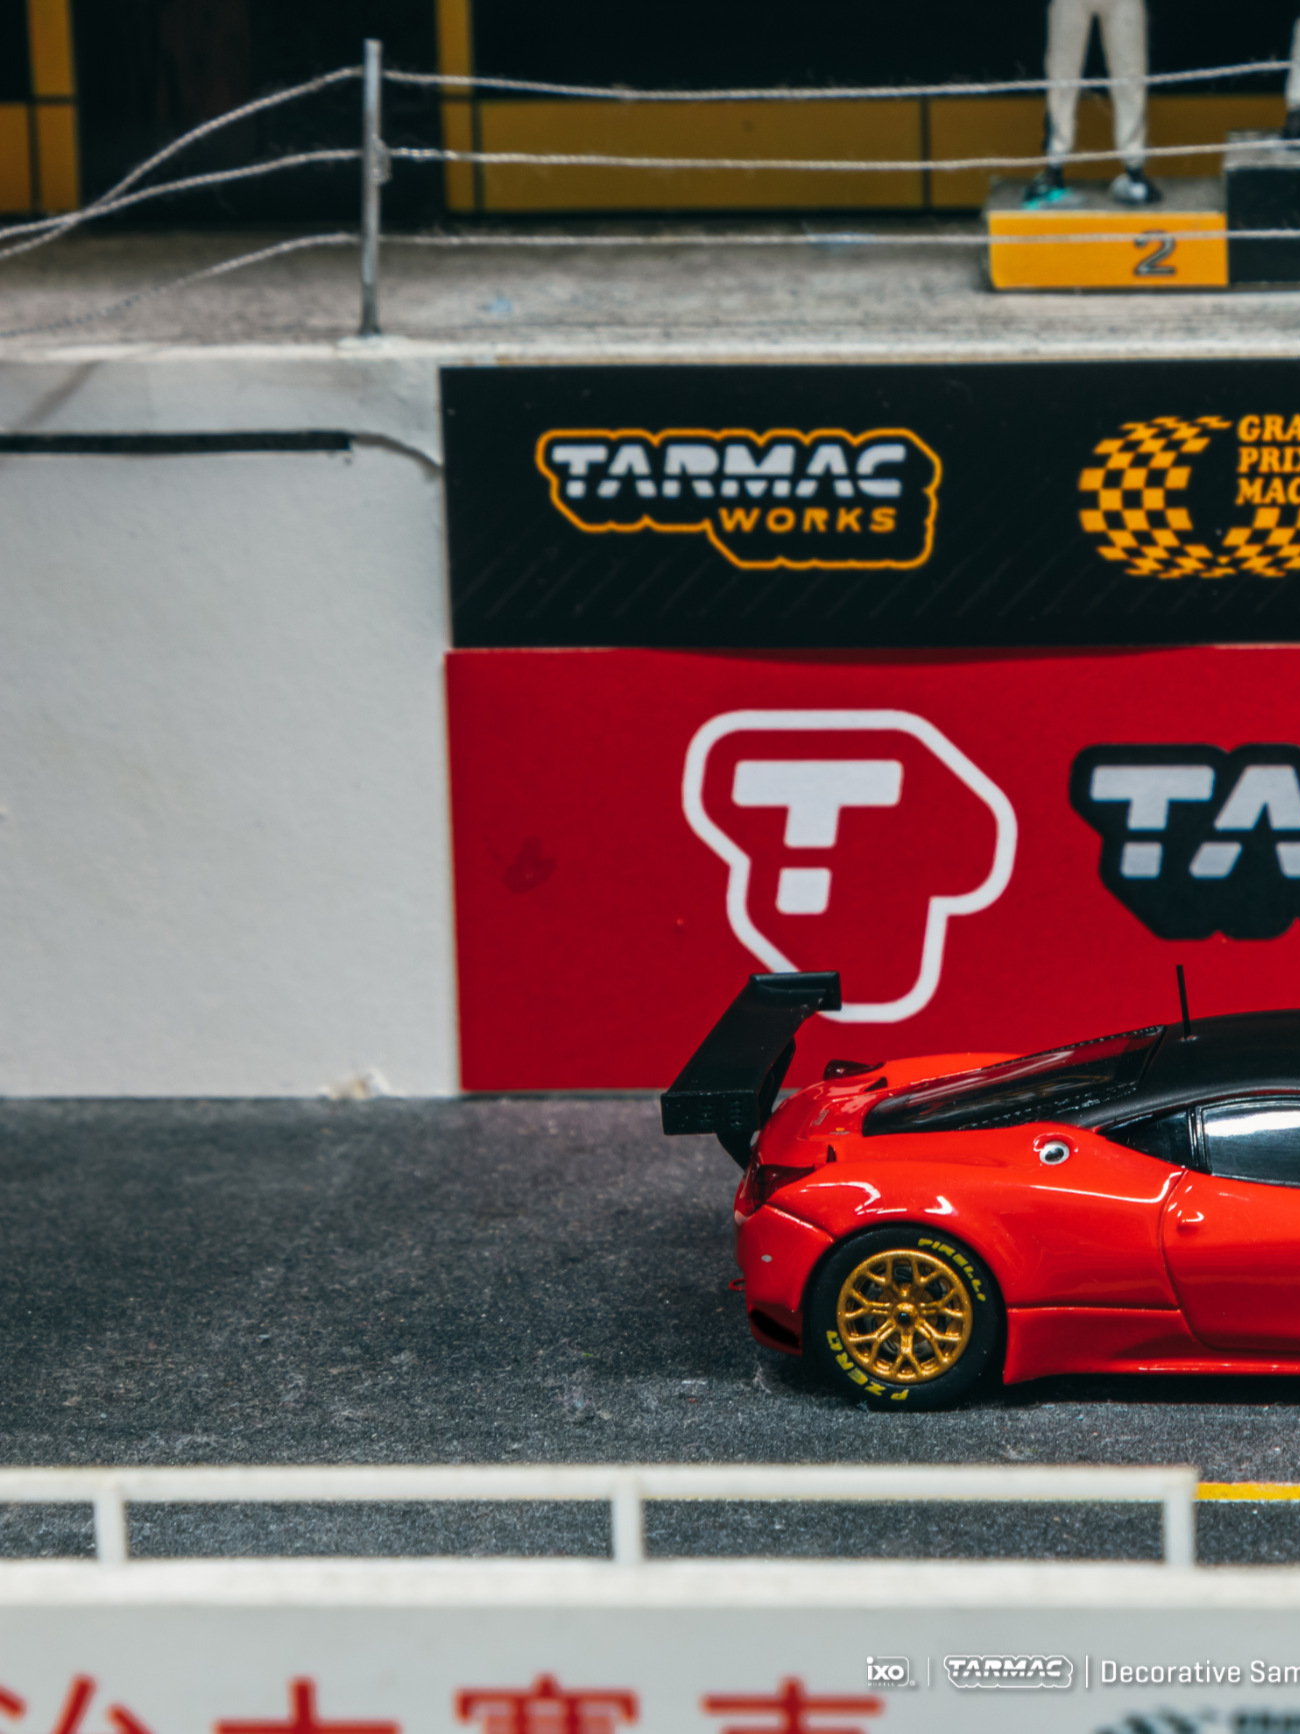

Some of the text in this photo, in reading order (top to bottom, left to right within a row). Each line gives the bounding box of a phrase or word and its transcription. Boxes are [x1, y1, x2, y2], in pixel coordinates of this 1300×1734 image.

[1134, 229, 1176, 276] 2
[552, 445, 906, 496] TARMAC
[720, 508, 895, 532] WORKS
[917, 1238, 986, 1301] PIRELLI
[826, 1330, 887, 1396] ZERO
